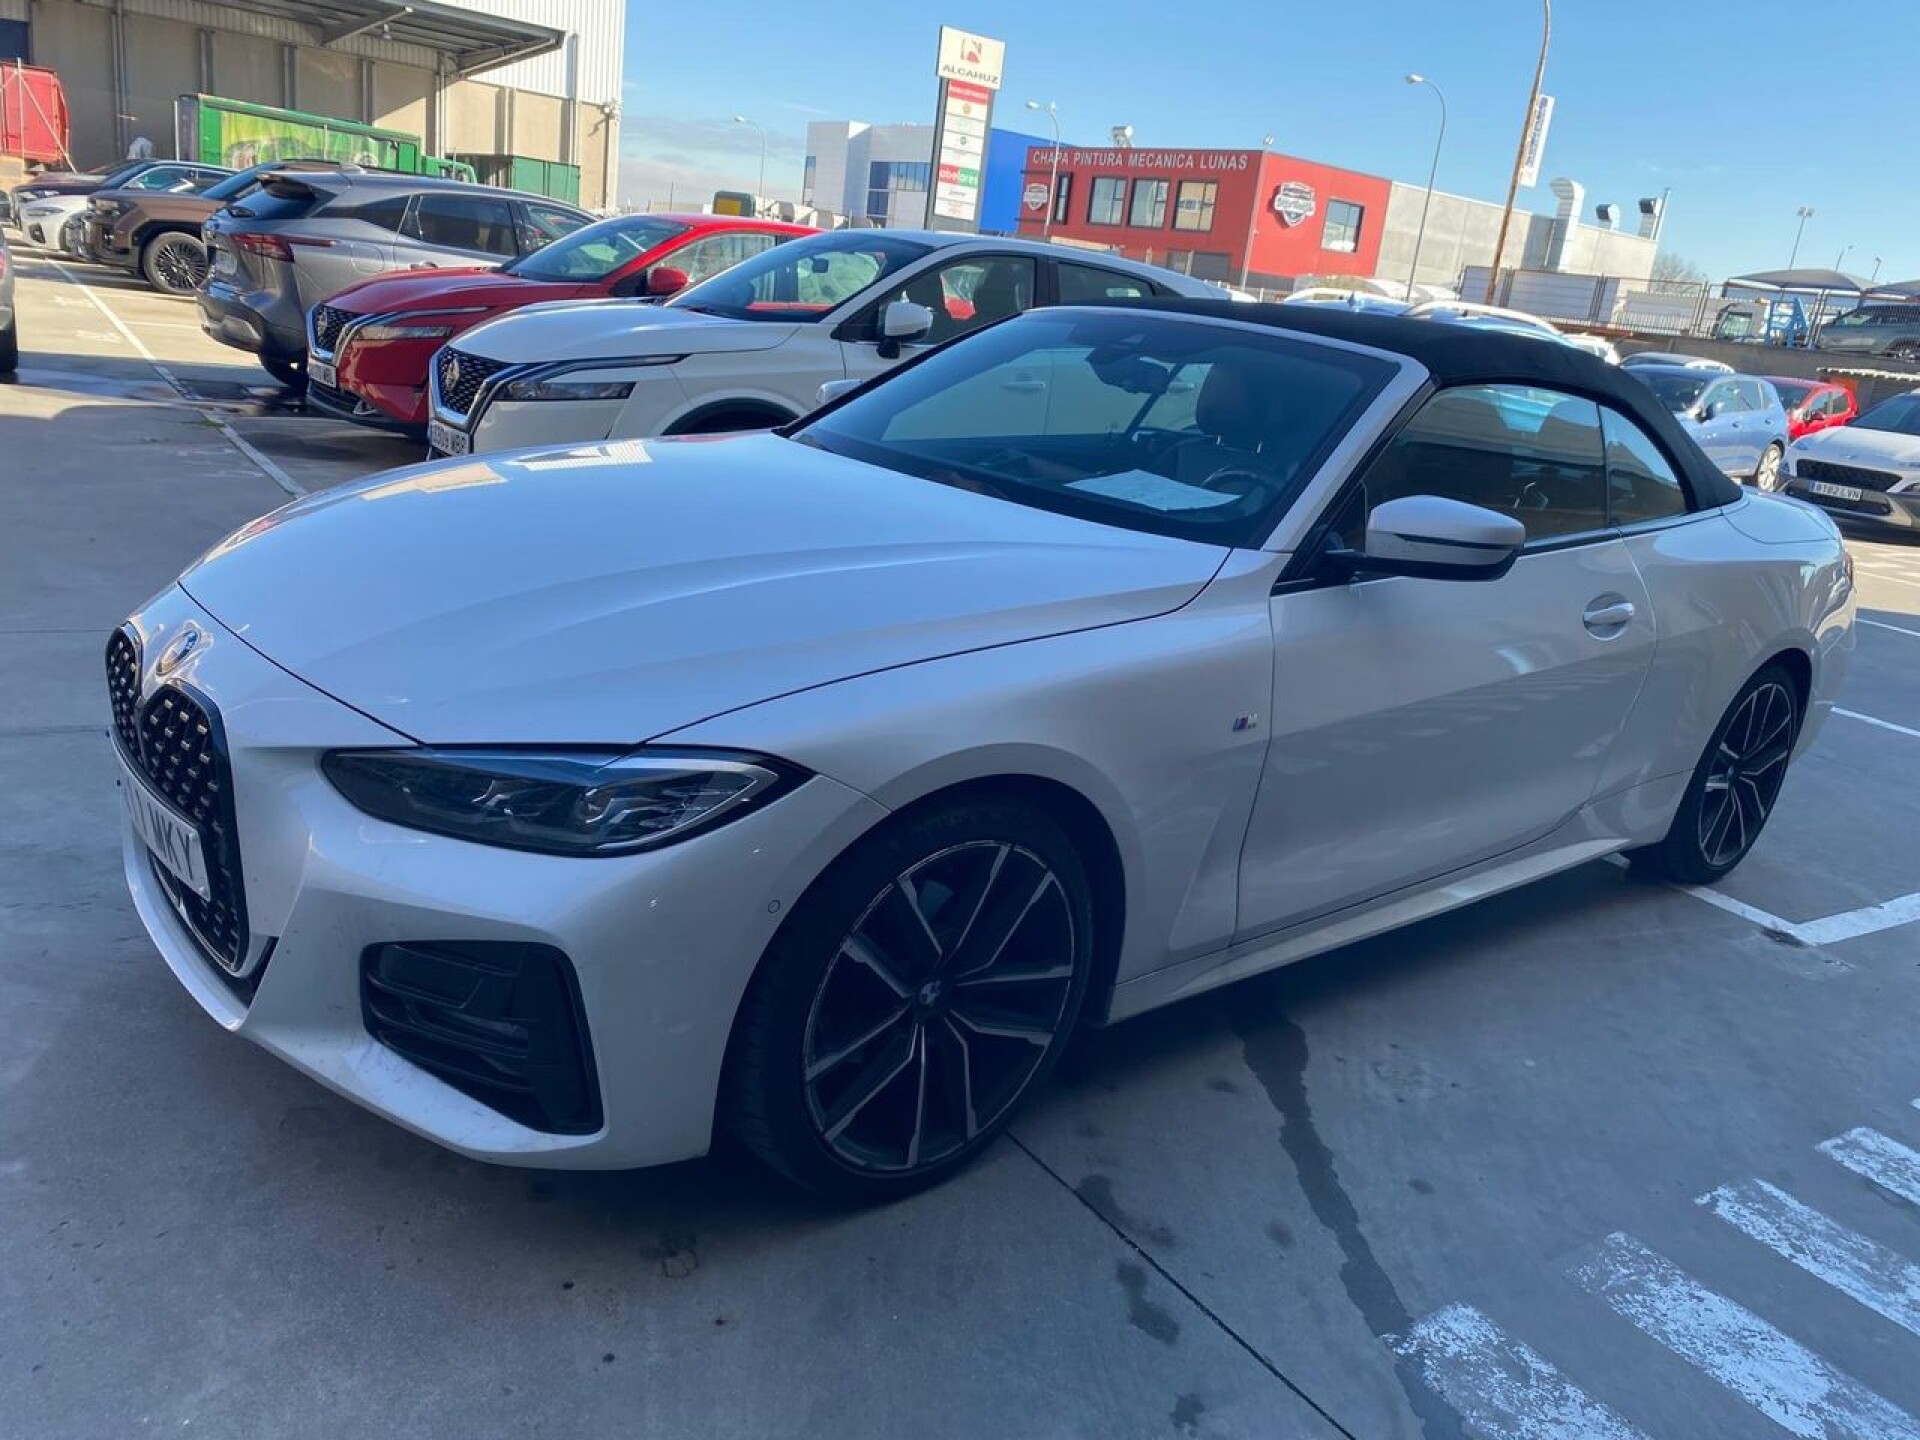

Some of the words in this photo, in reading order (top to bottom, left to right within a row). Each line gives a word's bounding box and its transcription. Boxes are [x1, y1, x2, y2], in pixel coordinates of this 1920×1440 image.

[1032, 150, 1068, 165] CHAPA
[1073, 152, 1123, 166] PINTURA
[1127, 152, 1194, 169] MECANICA
[1199, 153, 1249, 170] LUNAS
